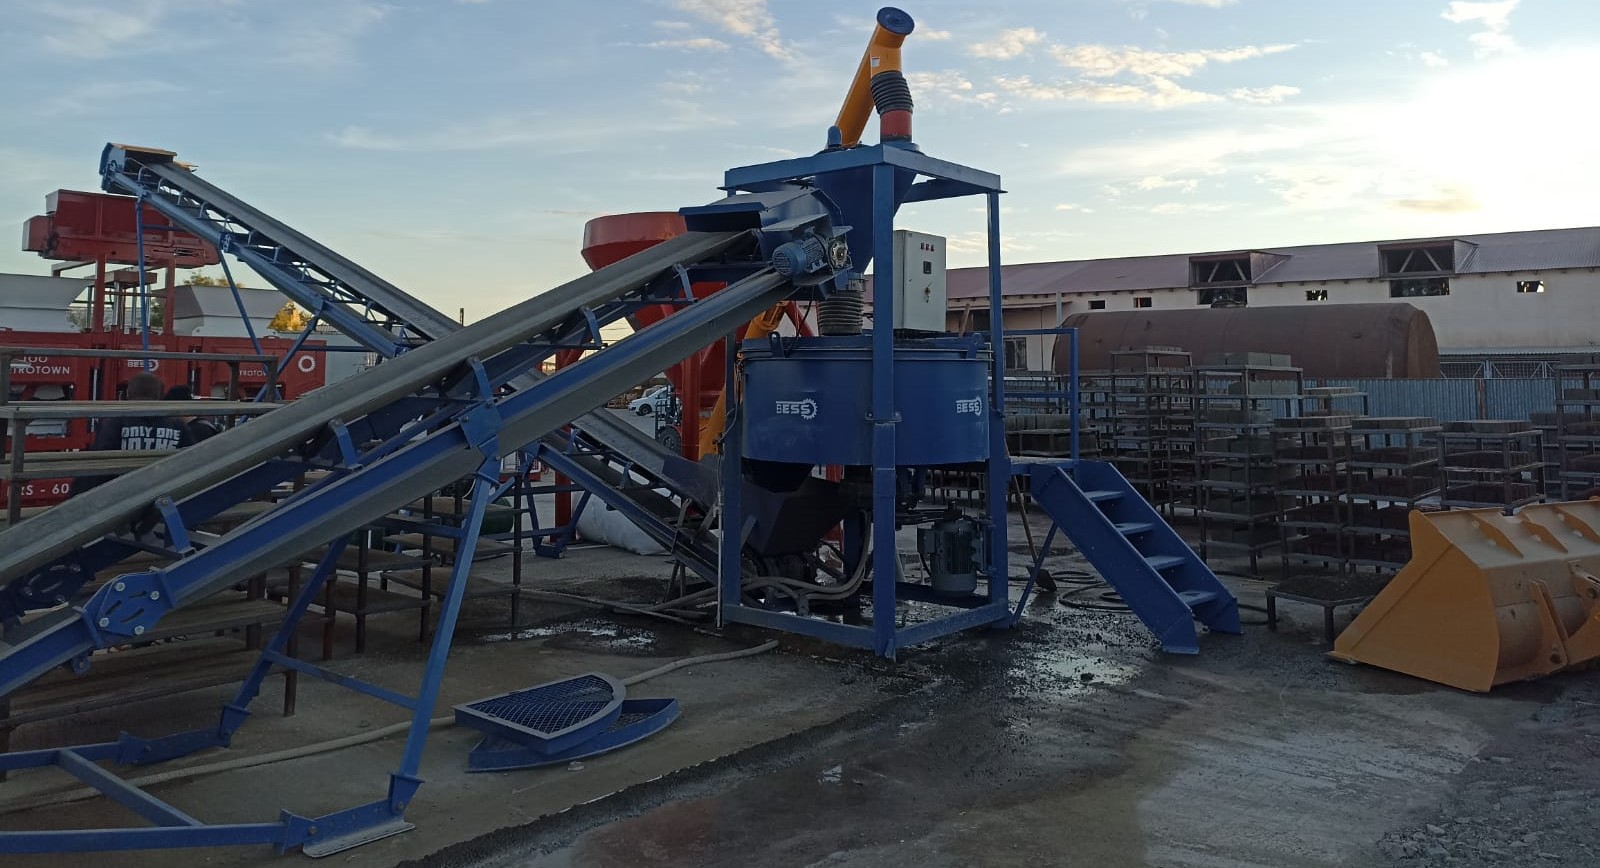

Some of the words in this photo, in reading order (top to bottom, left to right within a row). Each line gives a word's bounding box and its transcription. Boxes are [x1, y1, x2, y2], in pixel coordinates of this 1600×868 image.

[956, 401, 980, 414] BESS
[121, 426, 153, 438] ONLY
[156, 427, 180, 440] ONE
[52, 483, 69, 494] 60
